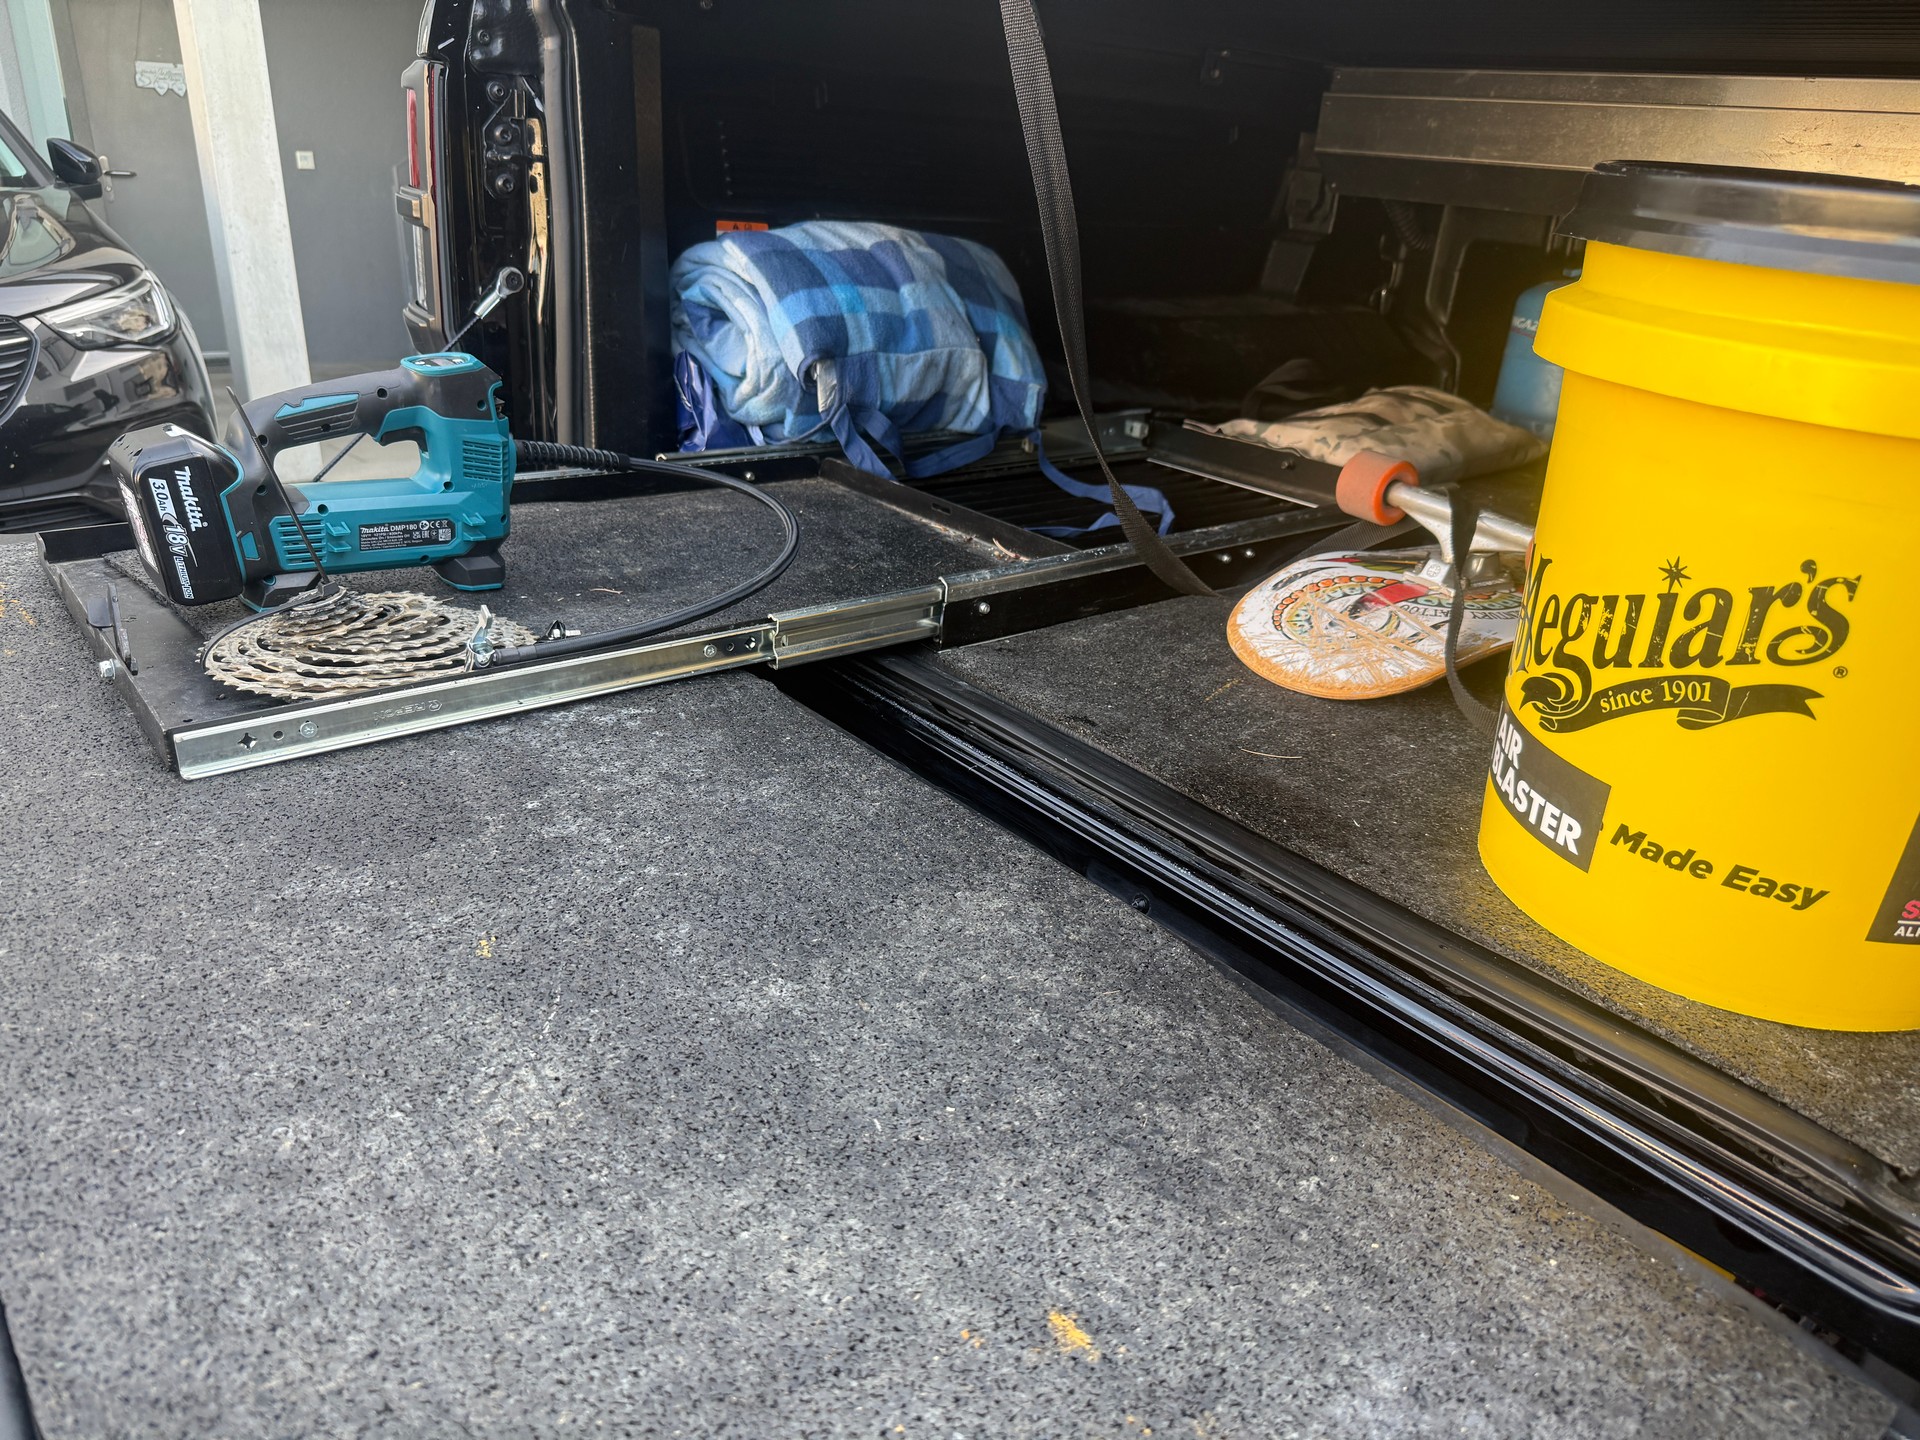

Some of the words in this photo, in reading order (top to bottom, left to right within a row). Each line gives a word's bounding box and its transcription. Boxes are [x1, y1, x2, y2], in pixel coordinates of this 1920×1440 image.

[162, 523, 188, 557] 18V
[390, 523, 418, 532] DMP180
[1600, 688, 1654, 714] since
[1660, 679, 1712, 703] 1901
[1498, 713, 1523, 770] AIR
[1492, 741, 1582, 855] BLASTER
[1609, 823, 1714, 880] Made
[1720, 863, 1831, 910] Easy
